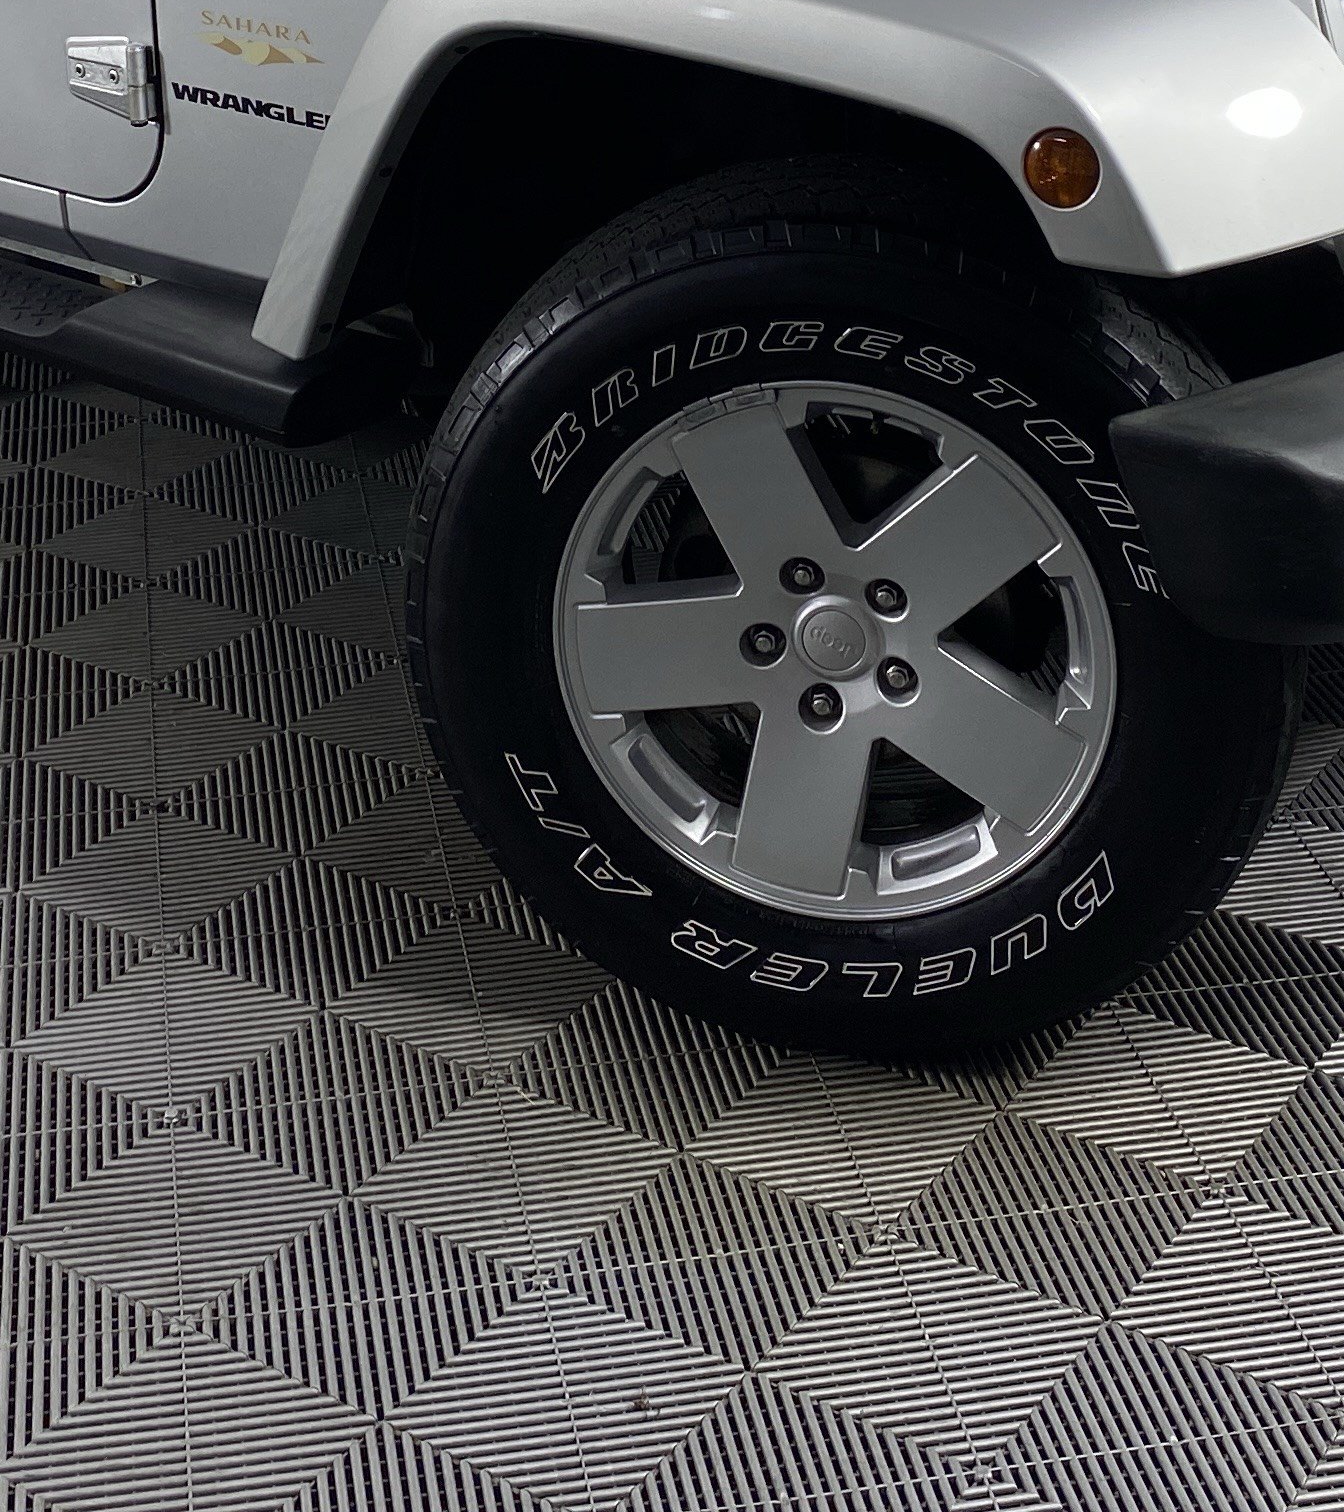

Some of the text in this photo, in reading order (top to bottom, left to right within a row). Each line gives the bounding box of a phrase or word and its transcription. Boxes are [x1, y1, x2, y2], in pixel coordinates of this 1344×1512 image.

[201, 9, 311, 45] SAHARA
[171, 81, 331, 131] WRANGLE
[504, 750, 1115, 999] DUELER A/T
